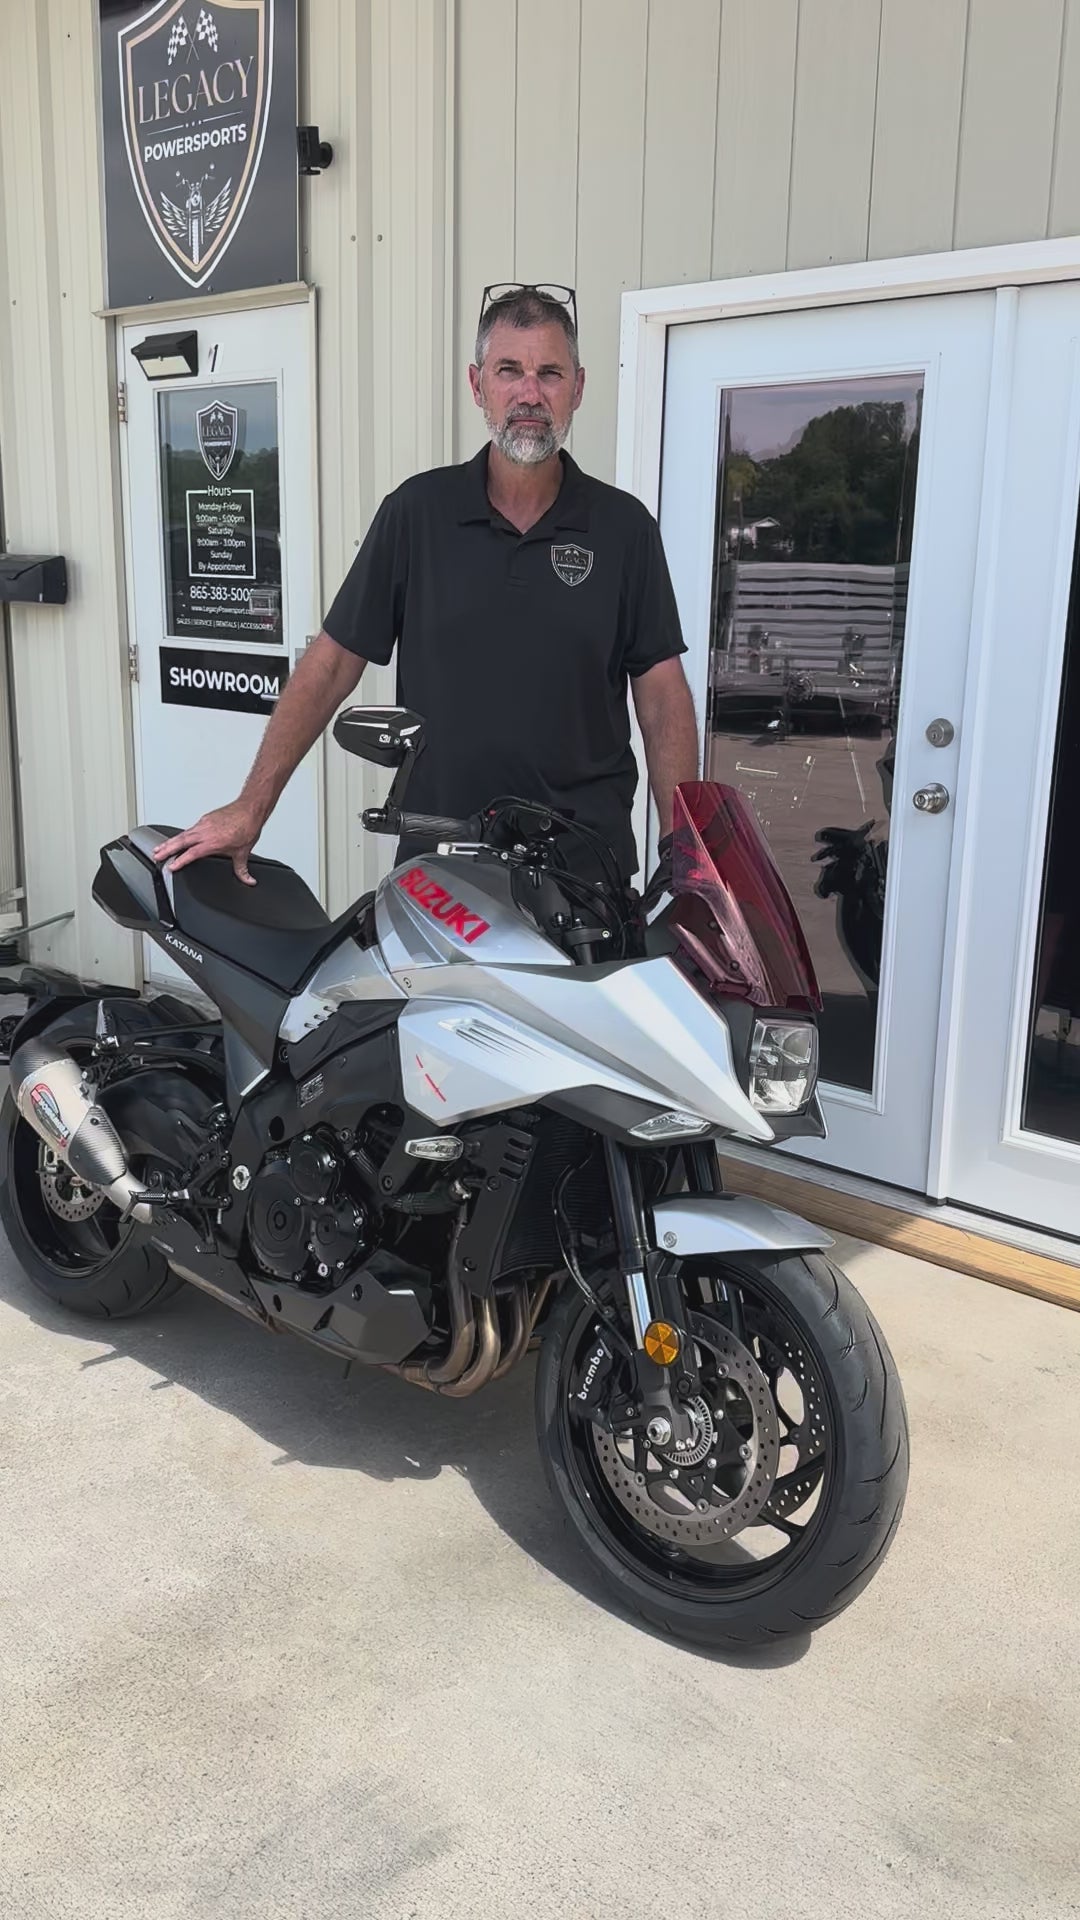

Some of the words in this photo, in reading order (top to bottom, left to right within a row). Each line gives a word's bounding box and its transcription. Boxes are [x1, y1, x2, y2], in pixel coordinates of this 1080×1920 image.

[138, 56, 254, 124] LEGACY
[144, 123, 247, 162] POWERSPORTS
[207, 485, 232, 497] Hours
[207, 526, 235, 537] Saturday
[198, 561, 206, 571] By
[207, 562, 246, 572] Appointment
[210, 550, 233, 560] Sunday
[169, 666, 280, 695] SHOWROOM
[398, 867, 492, 944] SUZUKI
[165, 933, 203, 963] KATANA
[577, 1348, 604, 1400] brembo
